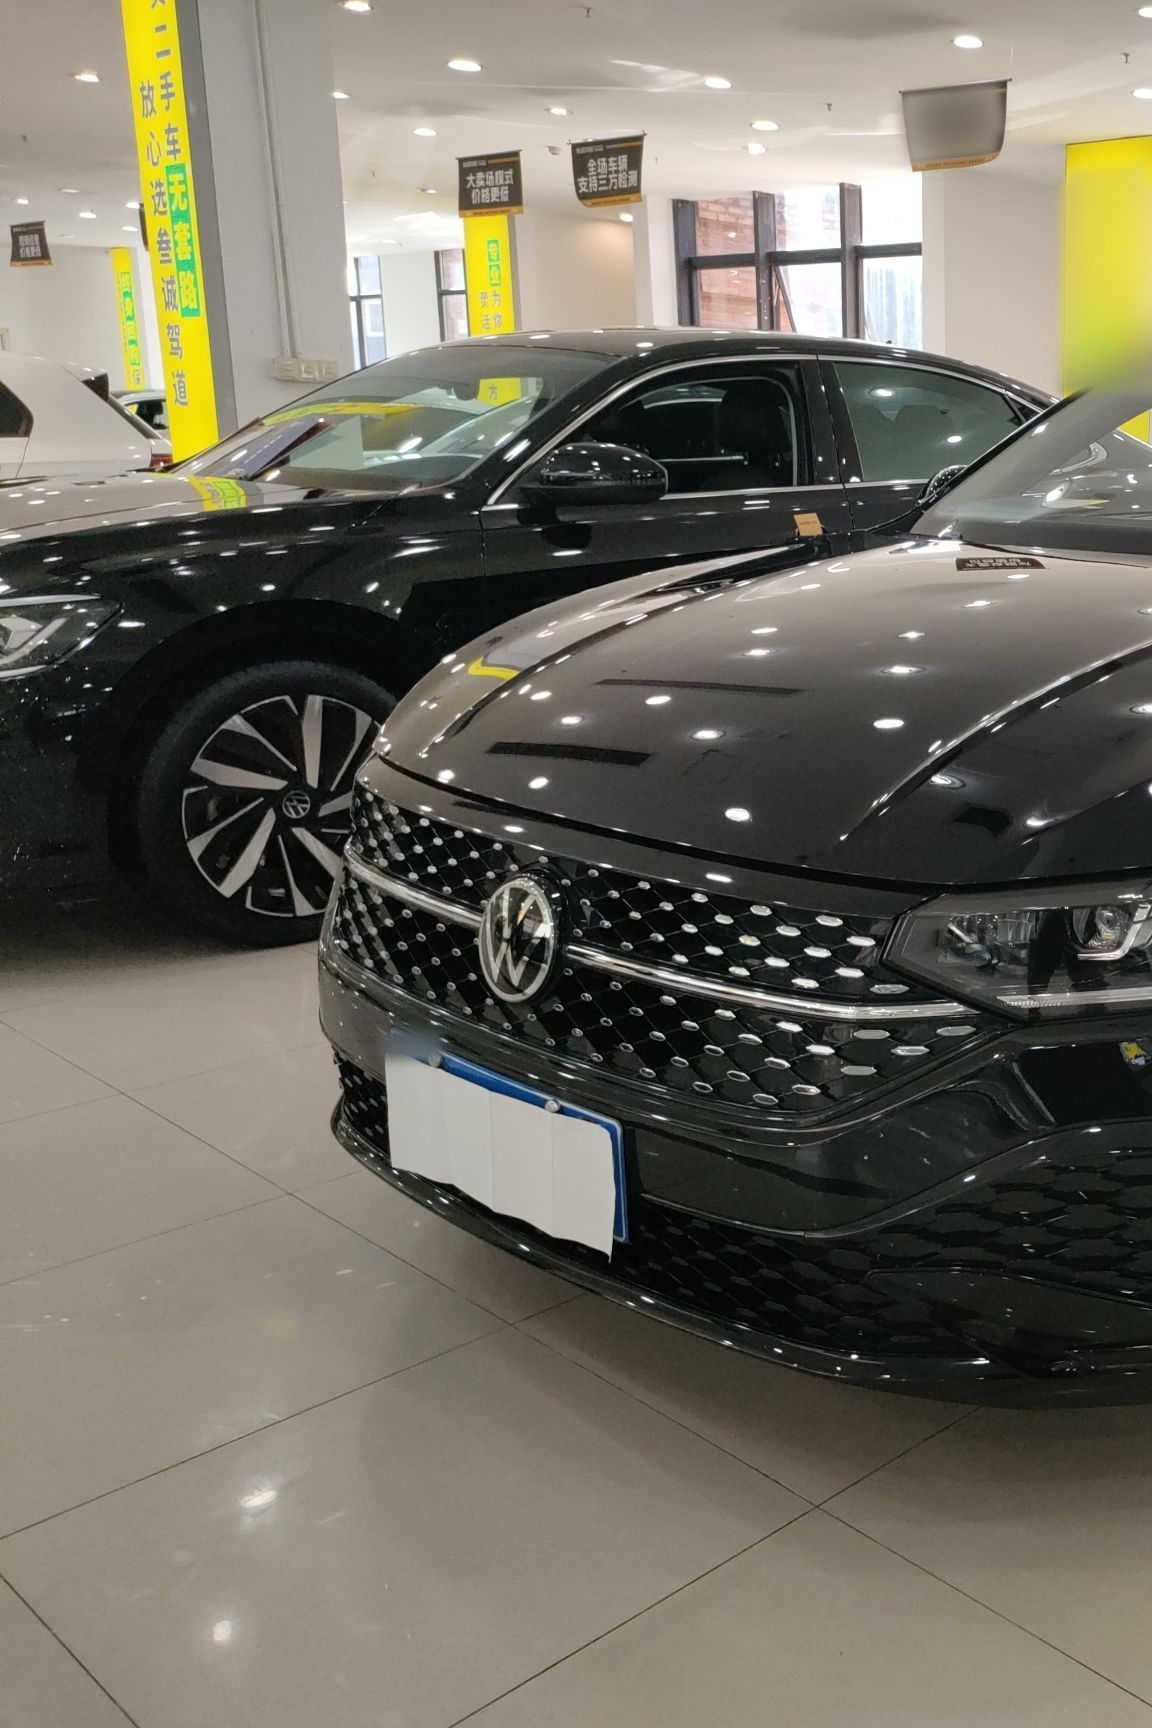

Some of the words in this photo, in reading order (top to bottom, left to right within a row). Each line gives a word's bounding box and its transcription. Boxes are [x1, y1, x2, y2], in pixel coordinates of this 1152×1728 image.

[150, 0, 199, 312] 二手车无套路
[587, 154, 628, 175] 全场车辆
[466, 168, 513, 188] 大卖场模式
[577, 169, 638, 193] 支持三方检测
[471, 186, 509, 204] 价格更低
[140, 80, 188, 408] 放心选叁诚驾道
